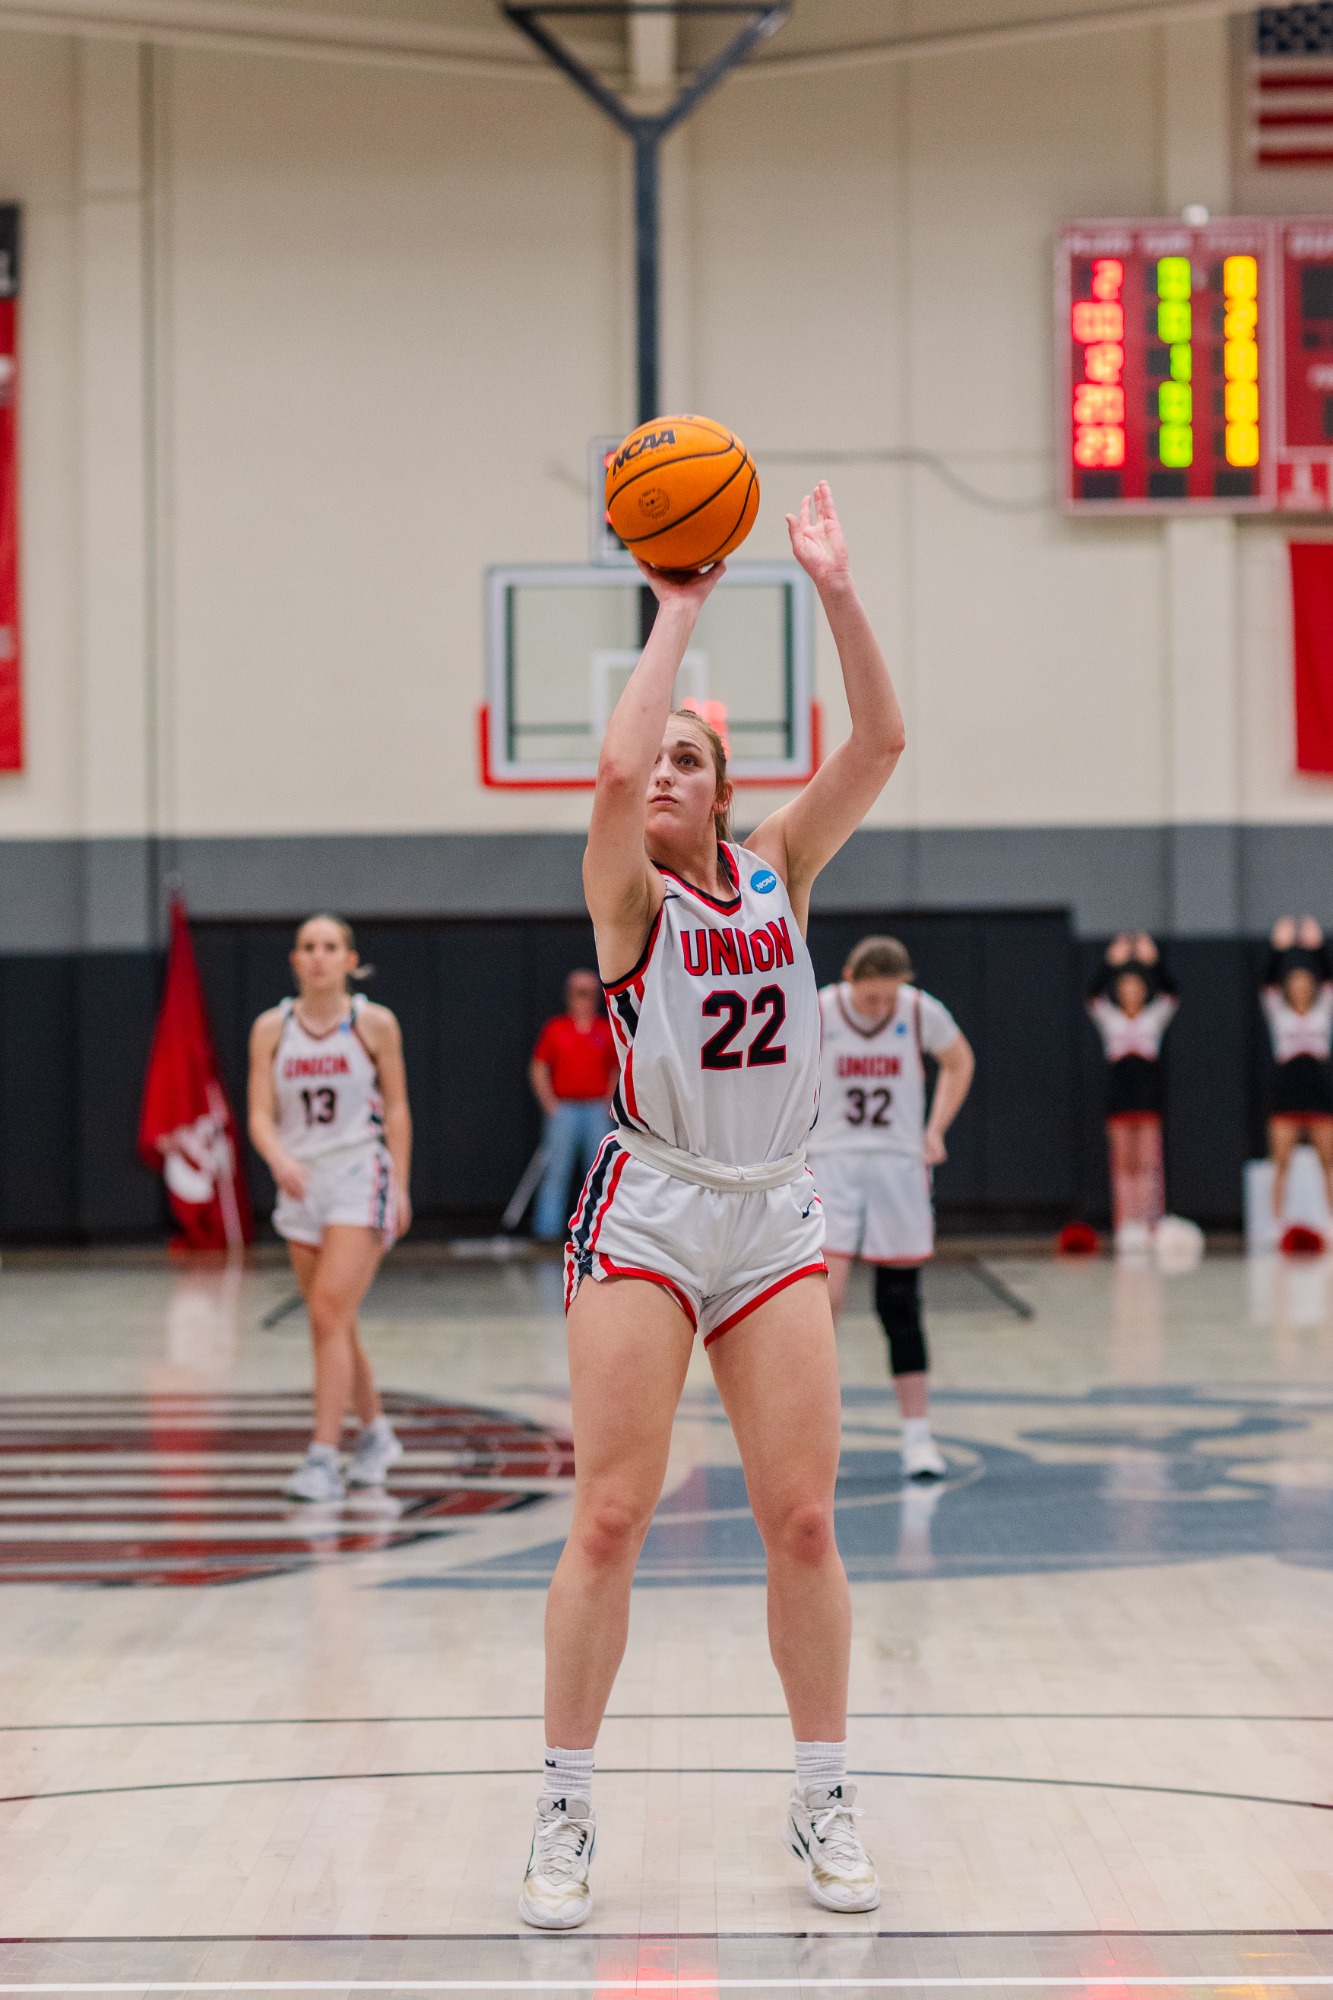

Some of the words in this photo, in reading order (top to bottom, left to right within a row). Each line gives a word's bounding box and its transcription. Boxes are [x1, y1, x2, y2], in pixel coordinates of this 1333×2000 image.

[612, 429, 676, 477] NCAA
[755, 875, 776, 891] NCAA
[680, 916, 794, 977] UNION
[701, 983, 787, 1071] 22
[301, 1086, 336, 1128] 13
[846, 1086, 892, 1128] 32
